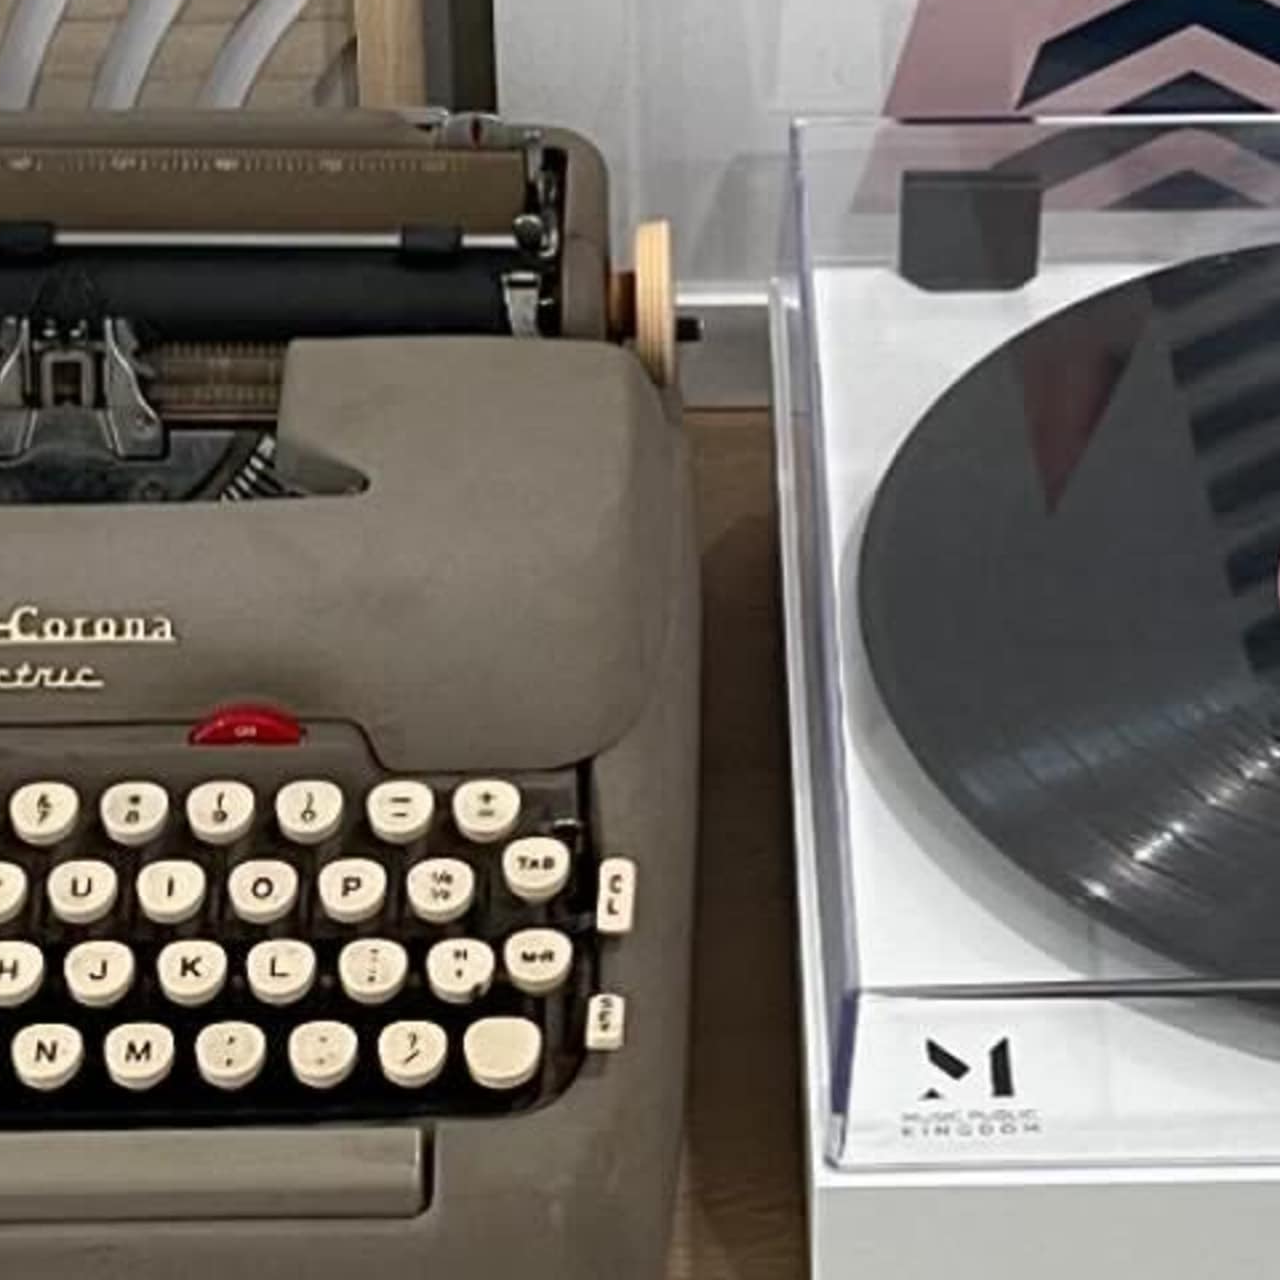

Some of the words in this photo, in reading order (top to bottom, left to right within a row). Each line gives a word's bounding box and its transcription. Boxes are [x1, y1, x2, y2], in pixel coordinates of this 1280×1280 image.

[69, 876, 93, 900] U
[249, 876, 275, 901] O
[340, 875, 363, 899] P
[516, 856, 557, 871] TAB
[87, 958, 109, 982] J
[179, 955, 203, 979] K
[268, 955, 291, 979] L
[33, 1039, 59, 1064] N
[124, 1039, 153, 1064] M
